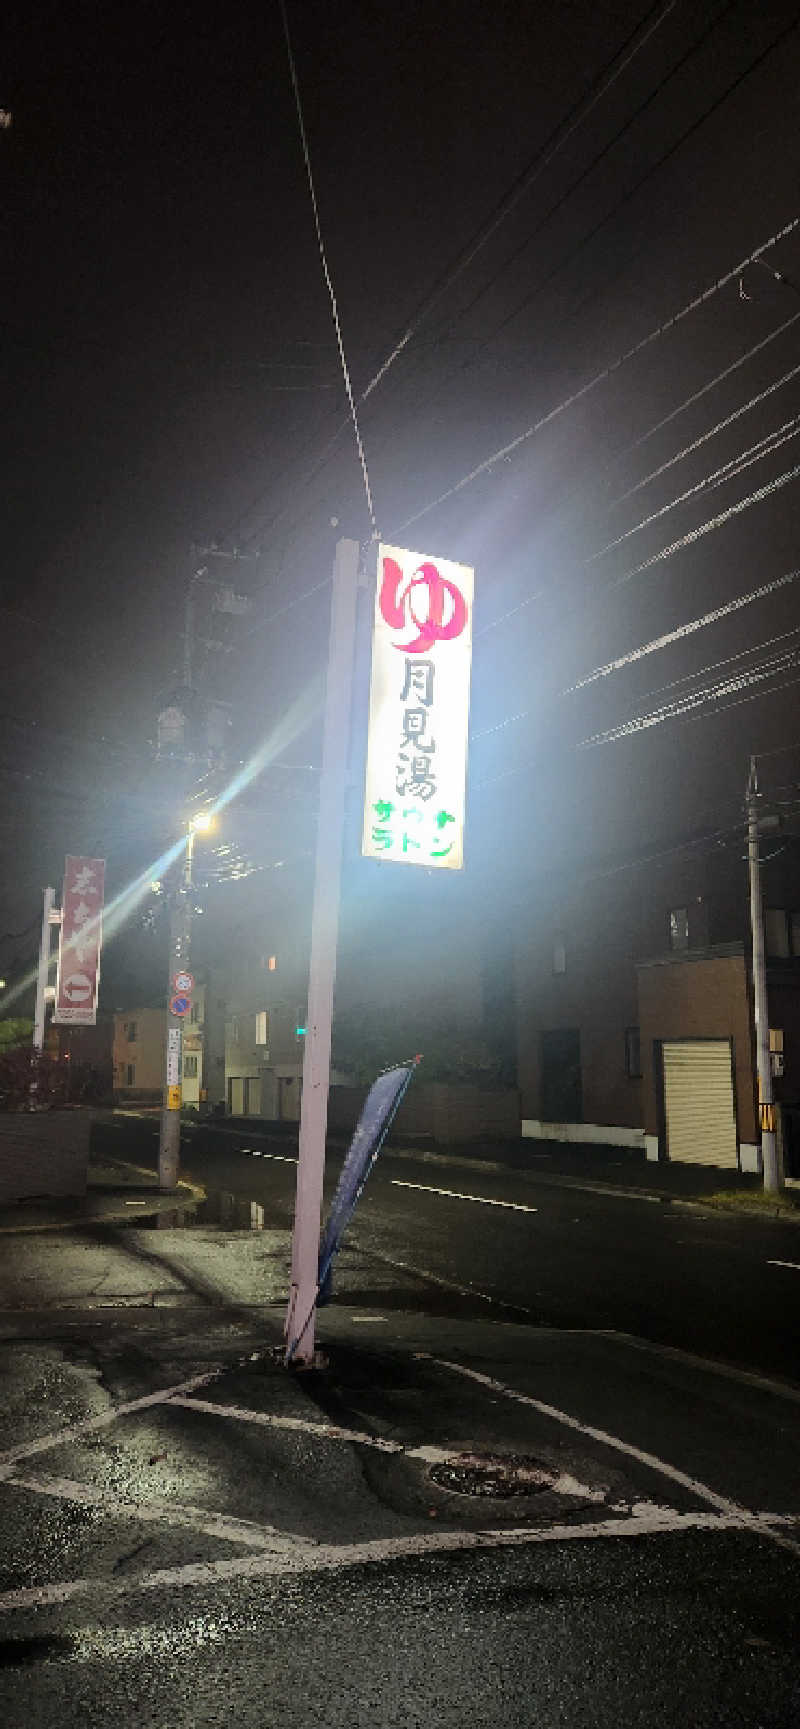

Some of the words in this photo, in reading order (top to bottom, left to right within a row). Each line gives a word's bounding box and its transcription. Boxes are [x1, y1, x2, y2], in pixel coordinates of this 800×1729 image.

[379, 557, 468, 653] ゆ
[396, 658, 436, 801] 月見湯
[372, 799, 456, 830] サウナ
